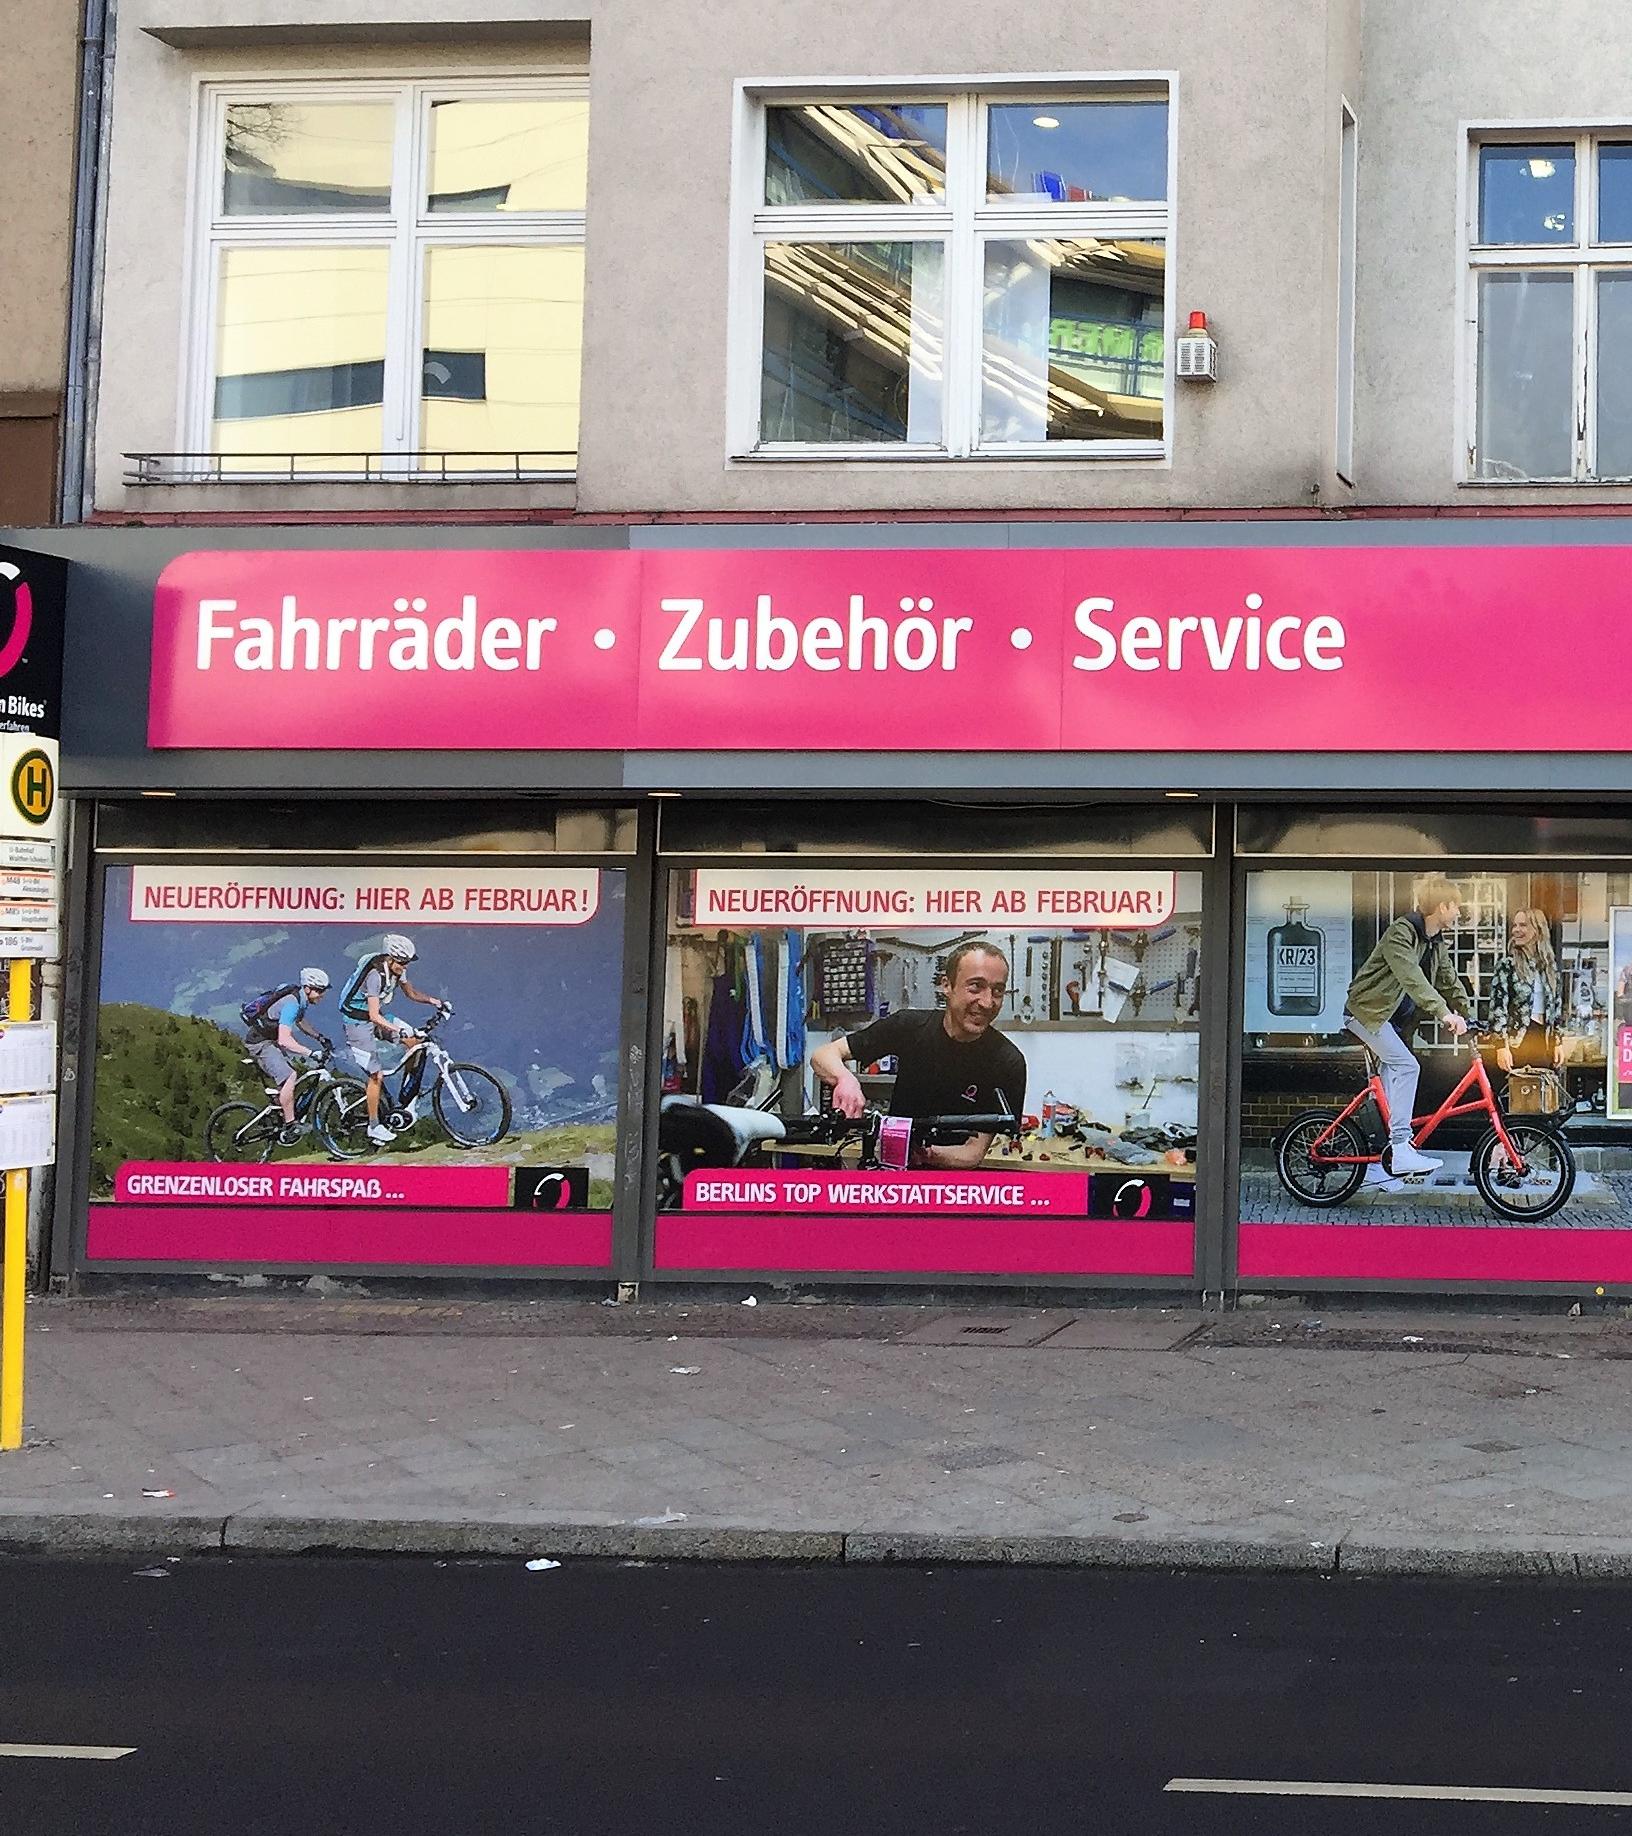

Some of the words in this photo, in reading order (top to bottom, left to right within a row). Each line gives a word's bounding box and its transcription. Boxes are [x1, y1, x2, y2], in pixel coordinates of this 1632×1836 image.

[197, 595, 558, 671] Fahrräder
[659, 595, 973, 672] Zubehör
[1073, 593, 1346, 672] Service
[8, 695, 45, 718] Bikes
[144, 882, 345, 910] NEUERÖFFNUNG:
[355, 888, 411, 911] HIER
[419, 889, 454, 911] AB
[708, 885, 916, 913] NEUERÖFFNUNG:
[926, 889, 980, 913] HIER
[991, 890, 1026, 913] AB
[1277, 948, 1316, 966] KR/23
[127, 1174, 273, 1197] GRENZENLOSER
[695, 1182, 776, 1203] BERLINS
[783, 1183, 821, 1204] TOP
[827, 1184, 1024, 1206] WERKSTATTSERVICE
